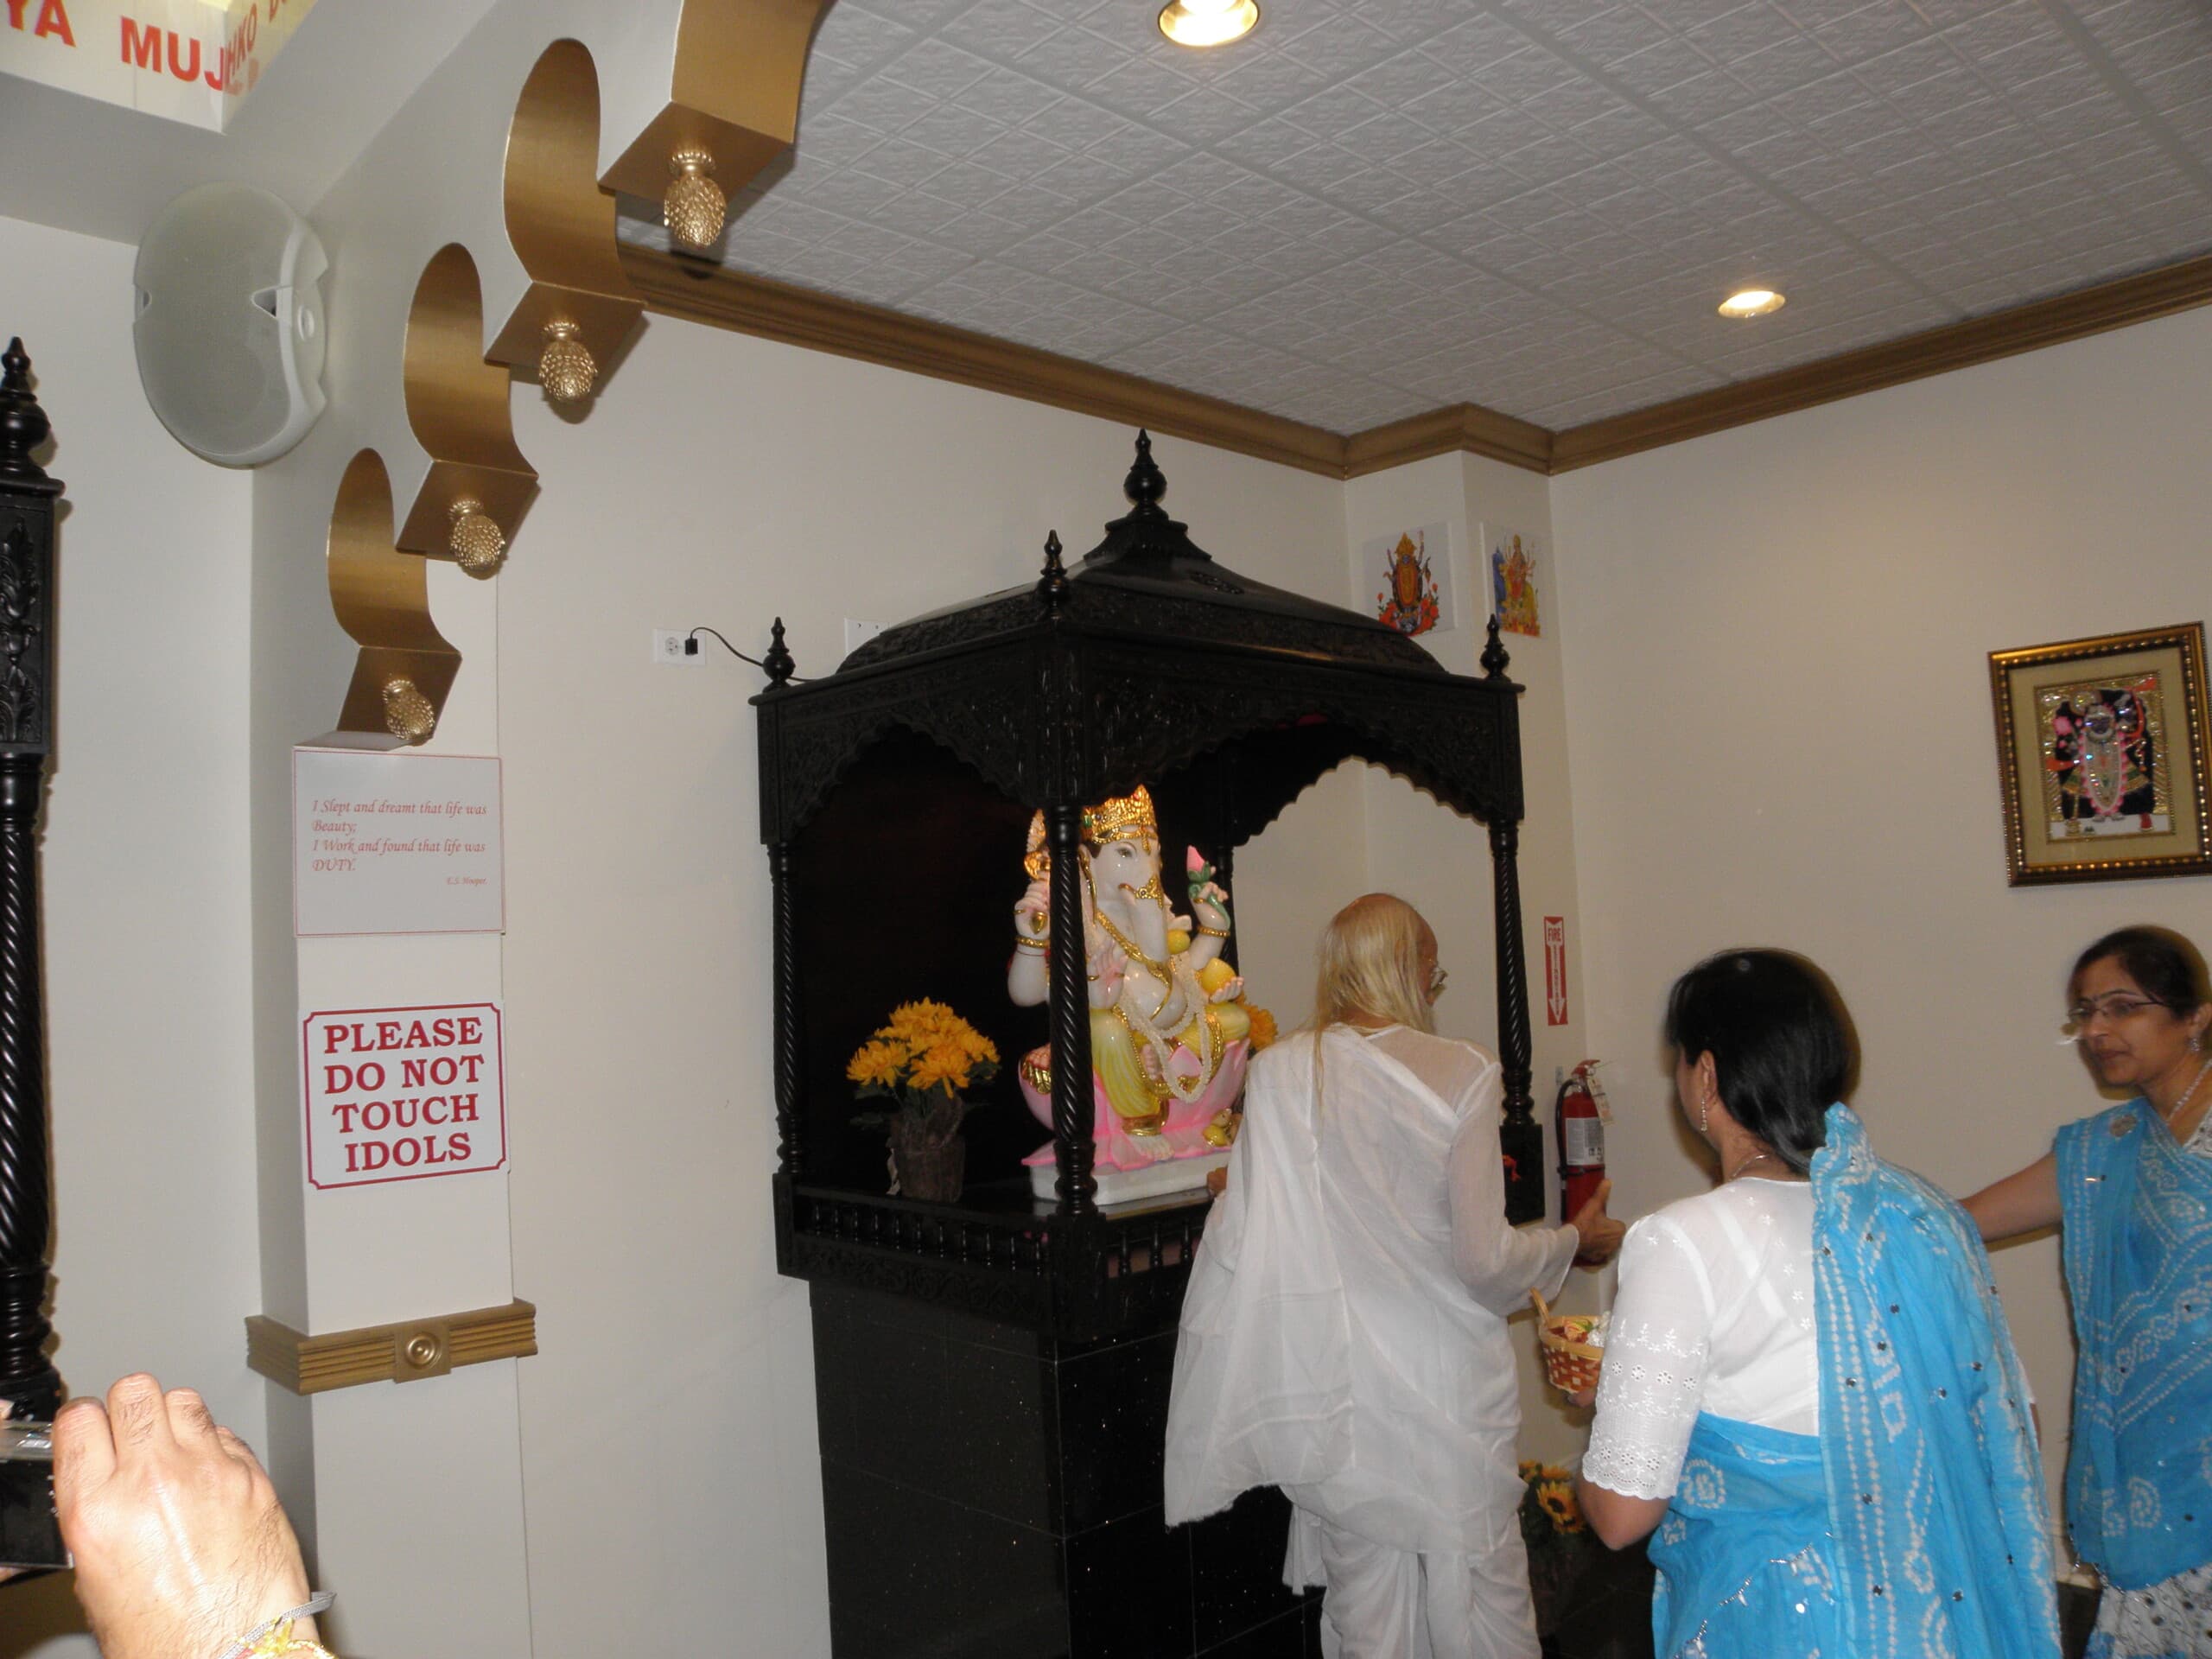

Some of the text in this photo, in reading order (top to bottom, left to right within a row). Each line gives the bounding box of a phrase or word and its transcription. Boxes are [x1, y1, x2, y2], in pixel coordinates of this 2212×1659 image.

[312, 798, 486, 818] I Slept and dreamt that life was
[313, 837, 486, 856] I Work and found that life was
[323, 1017, 483, 1054] PLEASE
[324, 1054, 484, 1094] DO NOT
[332, 1093, 479, 1133] TOUCH
[345, 1132, 472, 1173] IDOLS
